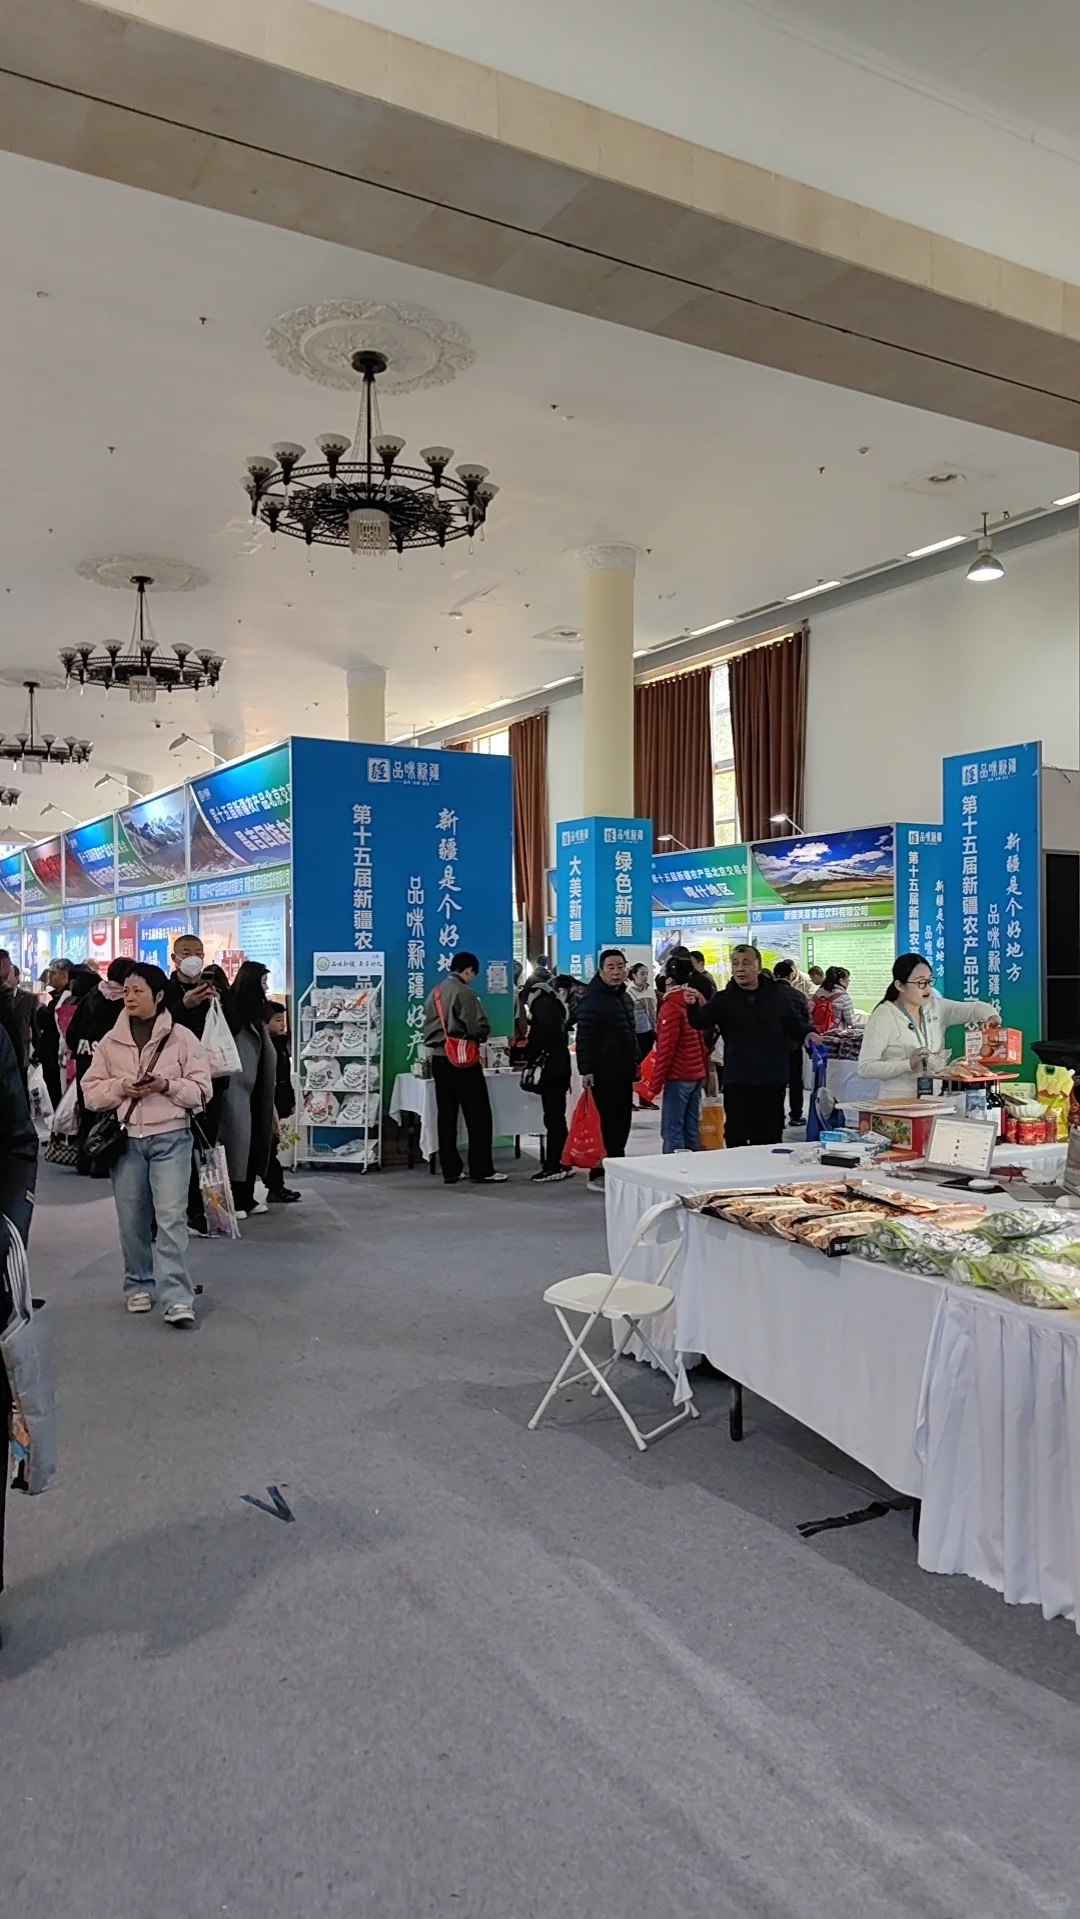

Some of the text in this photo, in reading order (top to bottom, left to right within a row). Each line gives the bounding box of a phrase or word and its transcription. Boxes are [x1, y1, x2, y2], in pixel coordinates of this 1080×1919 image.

[393, 760, 440, 781] 品味新疆
[234, 818, 290, 851] 昌吉回族自
[569, 855, 582, 941] 大美新疆
[615, 851, 633, 937] 绿色新疆
[683, 883, 735, 898] 喀什地区
[935, 880, 945, 977] 新疆是个好地方
[1004, 832, 1023, 982] 新疆是个好地方
